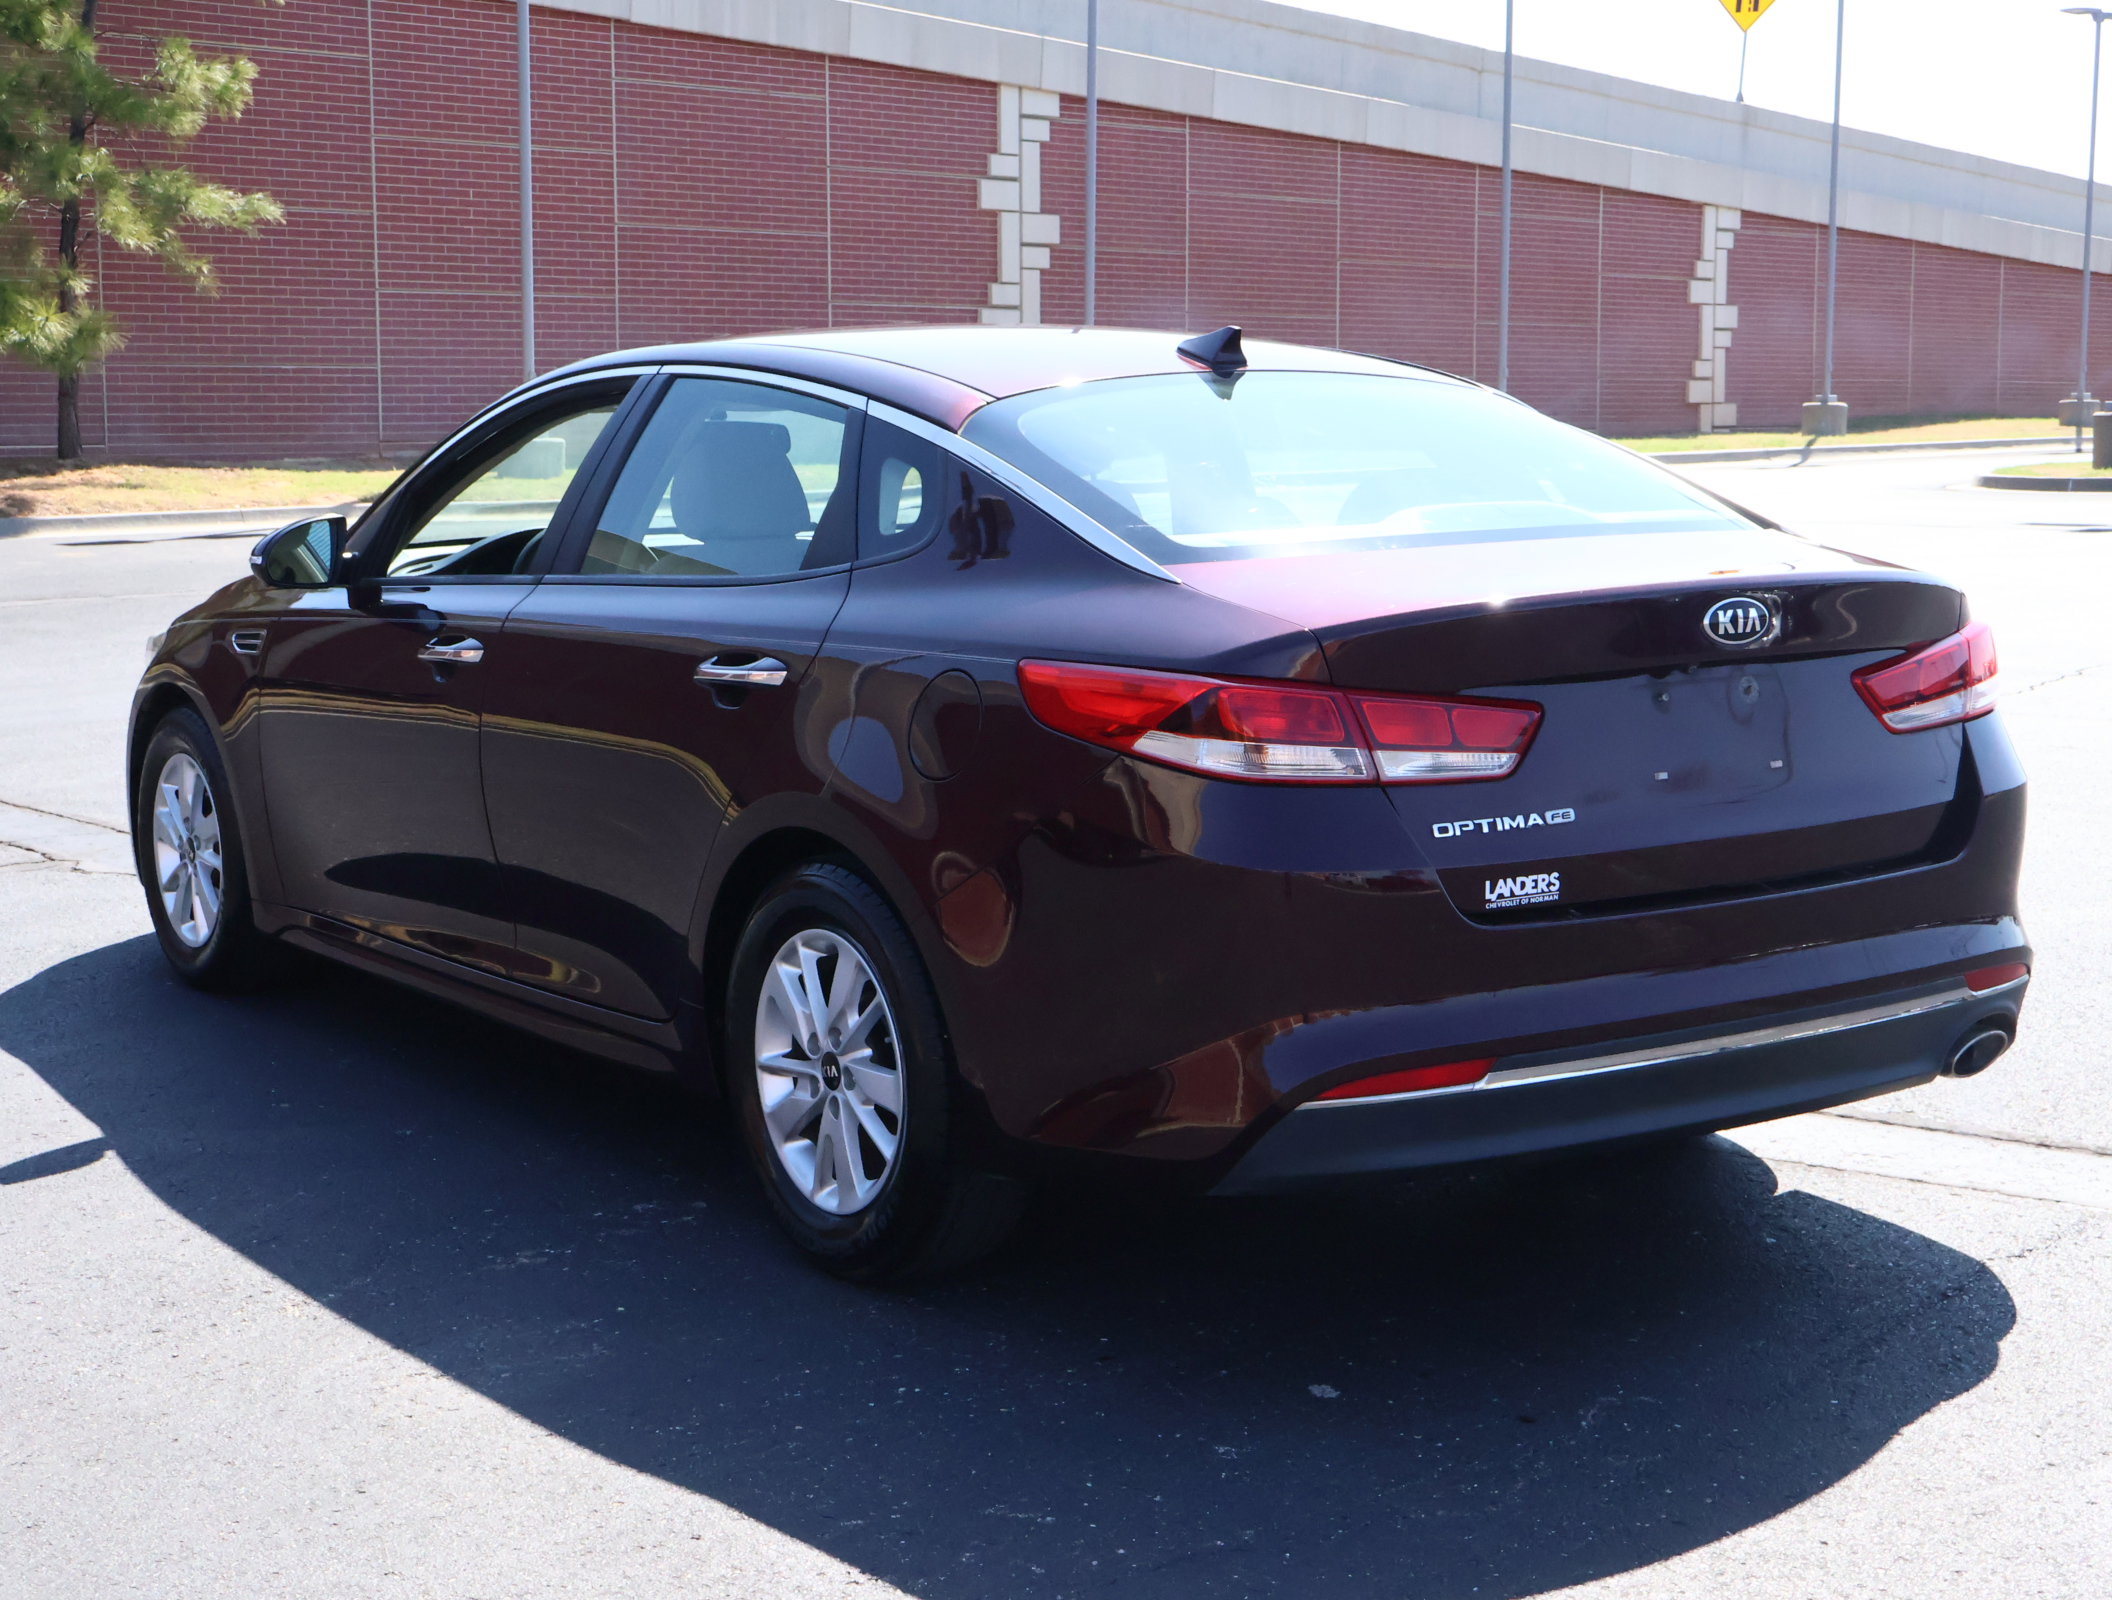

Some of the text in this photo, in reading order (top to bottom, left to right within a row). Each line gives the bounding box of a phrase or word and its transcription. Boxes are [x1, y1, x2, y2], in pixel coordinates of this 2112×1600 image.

[1717, 607, 1761, 635] KIA
[1432, 813, 1545, 838] OPTIMA
[1485, 872, 1560, 901] LANDERS
[1485, 900, 1520, 910] CHEVROLET
[1530, 894, 1559, 904] NORMAN
